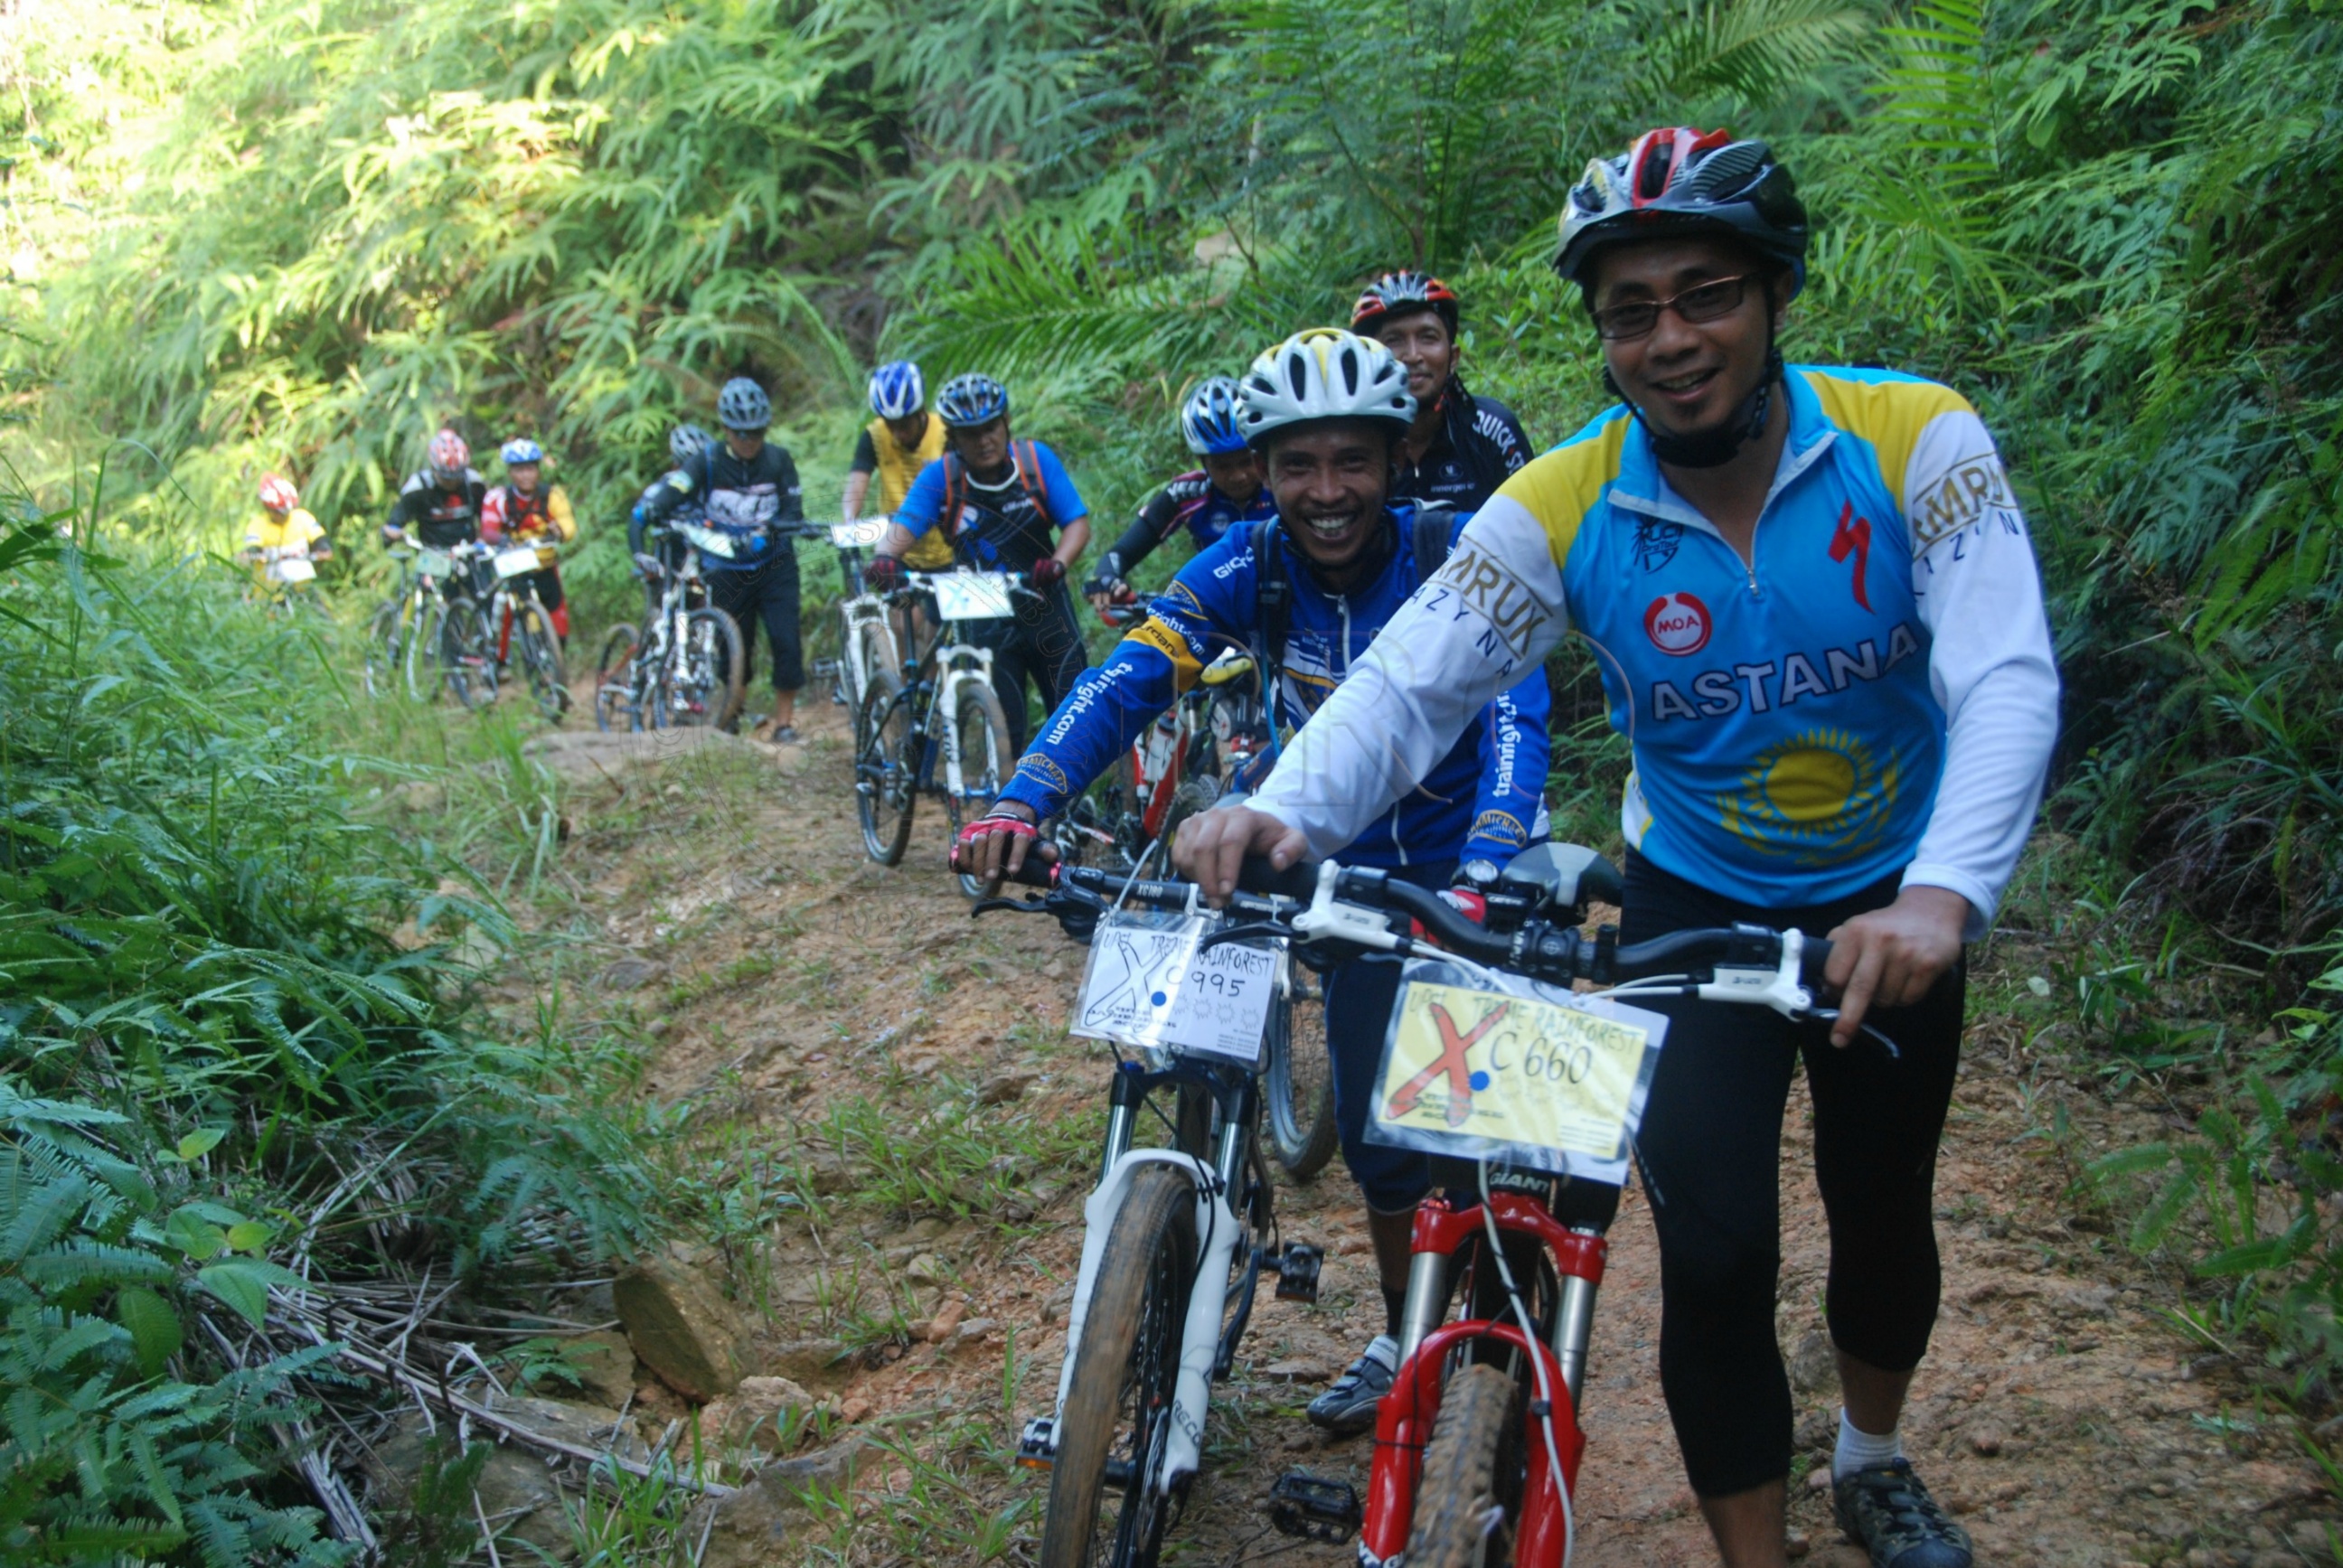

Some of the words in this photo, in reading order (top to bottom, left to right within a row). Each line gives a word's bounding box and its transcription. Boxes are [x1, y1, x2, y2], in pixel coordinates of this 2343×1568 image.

[1658, 615, 1700, 634] MOA
[1651, 621, 1920, 724] ASTANA
[1190, 971, 1246, 997] 995
[1523, 1037, 1594, 1084] 660
[1489, 1172, 1549, 1192] GIANT
